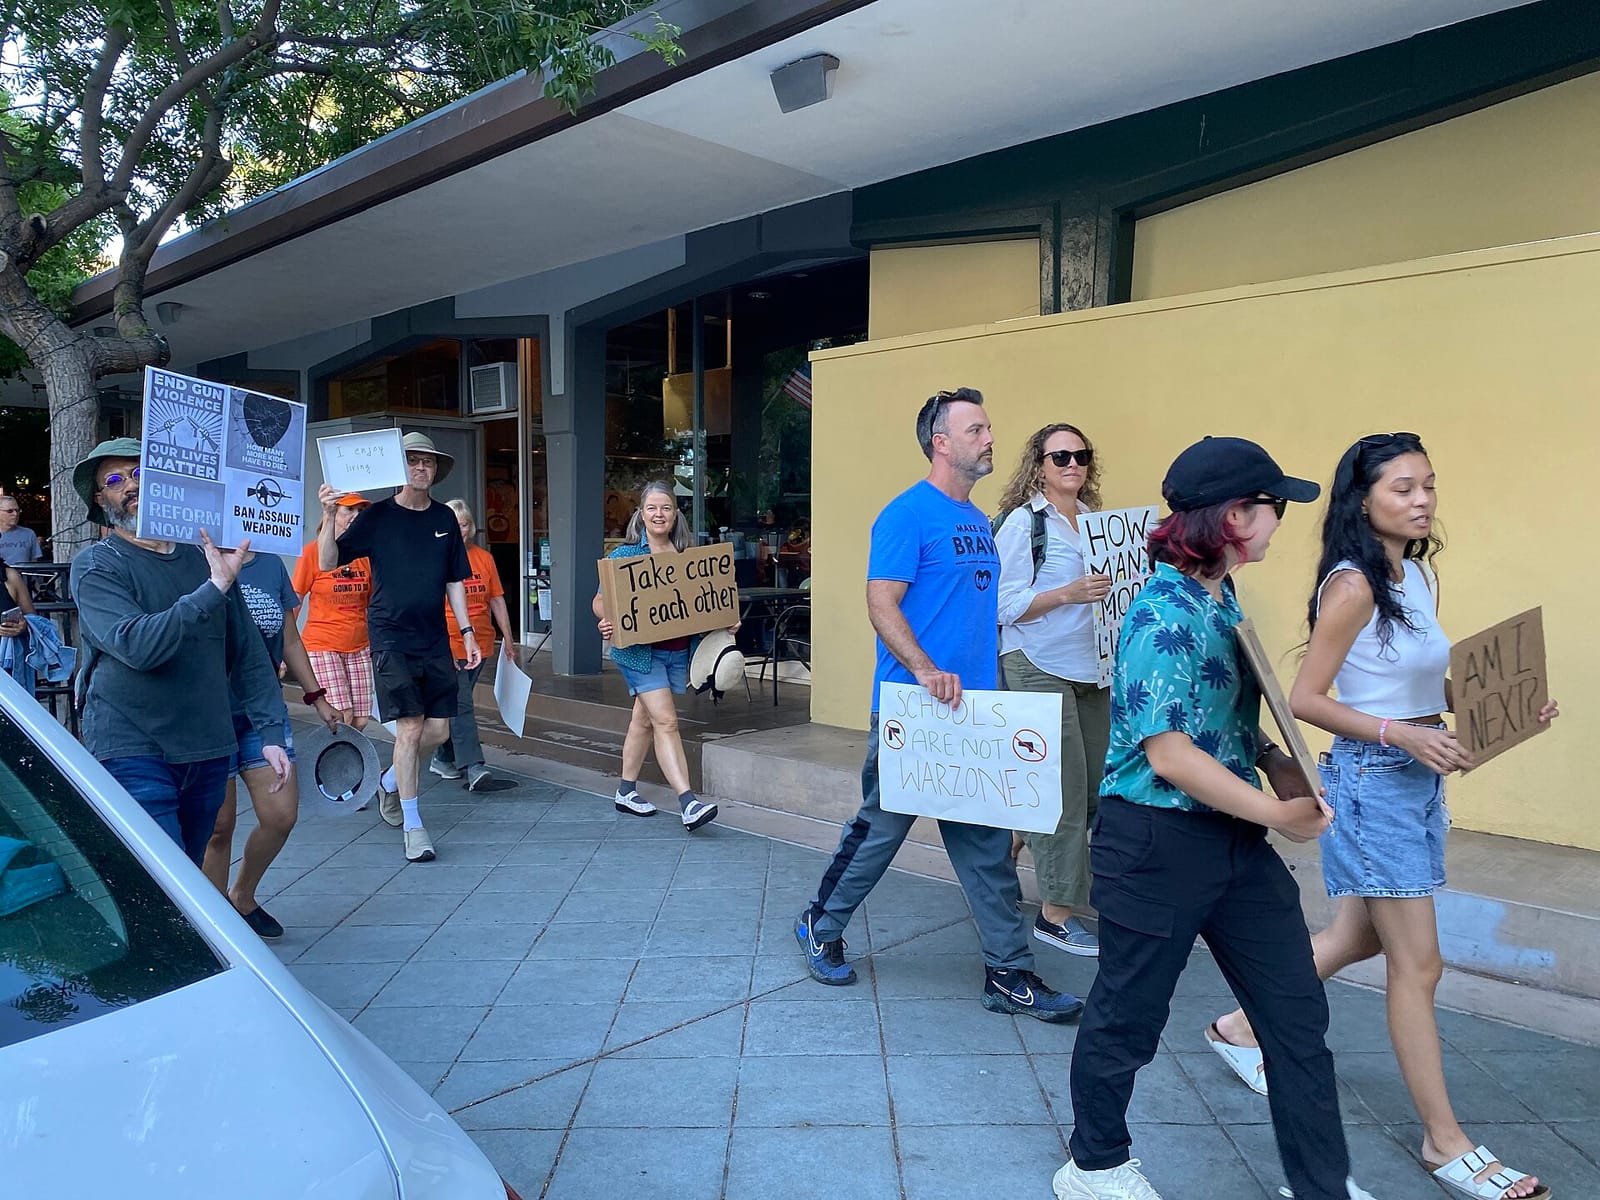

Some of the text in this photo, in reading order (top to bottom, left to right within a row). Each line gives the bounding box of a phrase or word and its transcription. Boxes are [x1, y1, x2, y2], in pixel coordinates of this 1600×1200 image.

[154, 373, 223, 400] END GUN
[153, 386, 221, 412] VIOLENCE
[149, 443, 217, 465] OUR LIVES
[246, 443, 285, 457] HOW MANY
[246, 450, 284, 463] MORE KIDS
[336, 446, 384, 458] I enjoy
[148, 455, 216, 479] MATTER
[242, 456, 261, 466] HAVE
[272, 462, 288, 471] DIE?
[345, 464, 371, 475] living
[149, 482, 185, 502] GUN
[149, 501, 220, 526] REFORM
[234, 505, 300, 526] BAN ASSAULT
[150, 521, 193, 540] NOW
[242, 520, 292, 537] WEAPONS
[956, 524, 978, 533] MAKE
[1086, 510, 1150, 556] HOW
[619, 554, 731, 592] Take care
[1090, 546, 1148, 587] MAN
[621, 581, 736, 632] of each other
[1462, 621, 1532, 698] AM I
[896, 691, 1007, 728] SCHOOLS
[1469, 677, 1538, 752] NEXT?
[912, 729, 1005, 760] ARE NOT
[899, 757, 1040, 808] WARZONES
